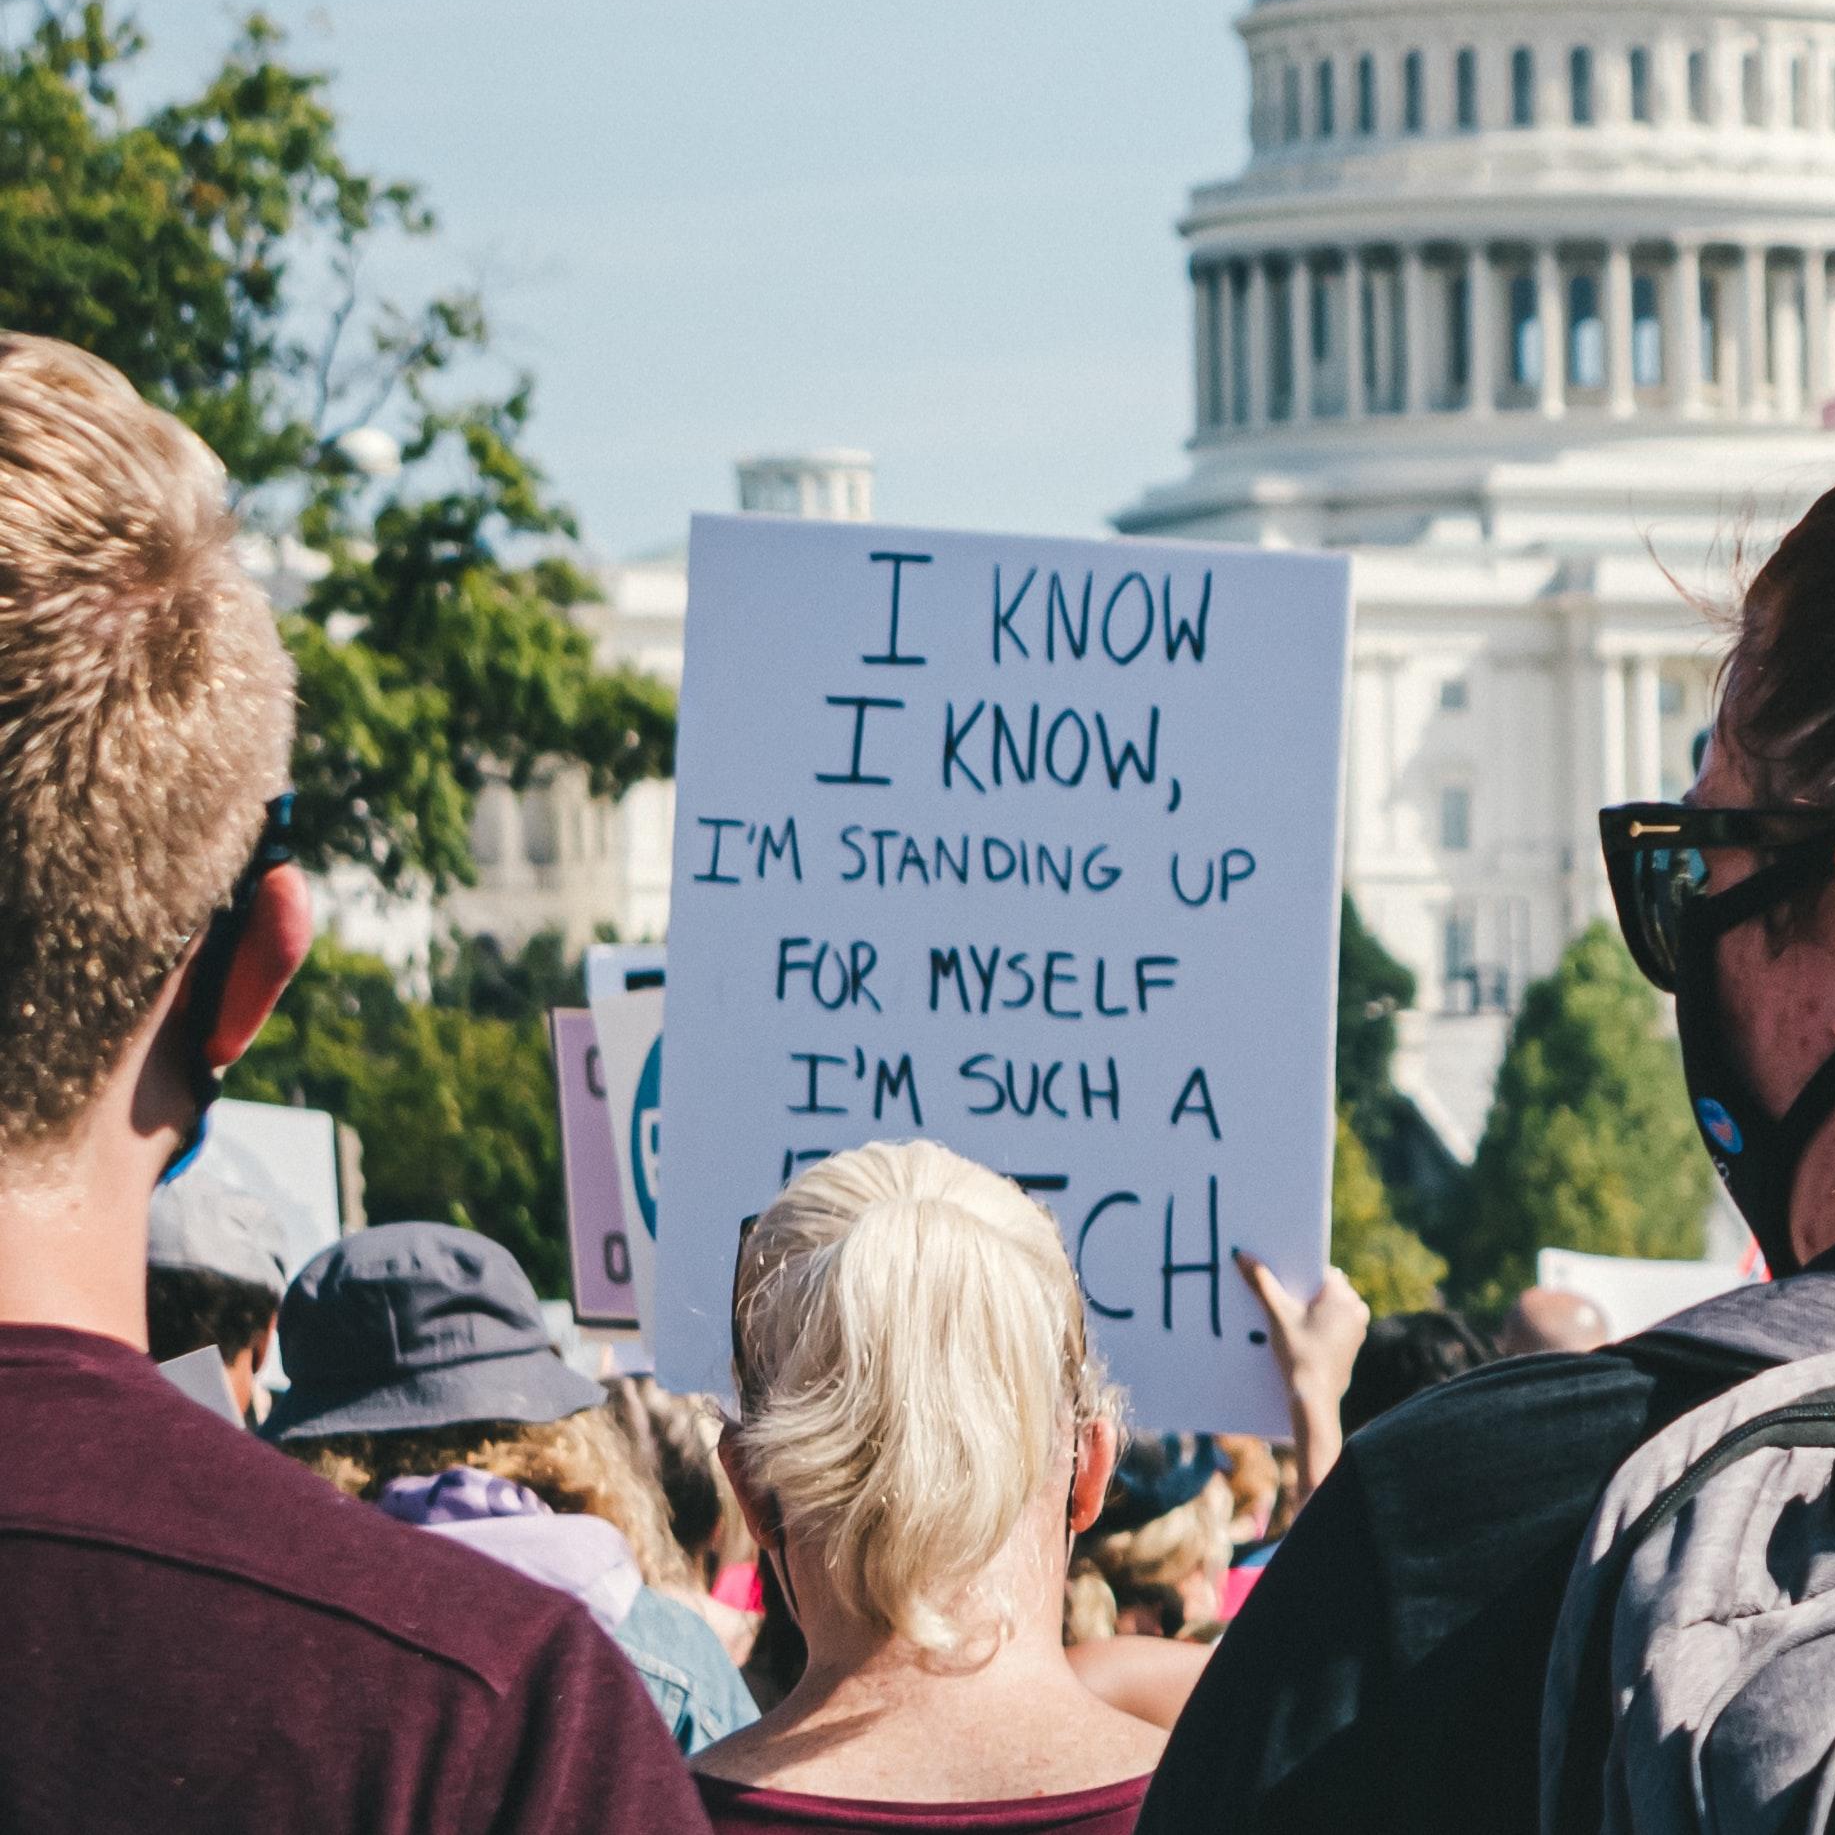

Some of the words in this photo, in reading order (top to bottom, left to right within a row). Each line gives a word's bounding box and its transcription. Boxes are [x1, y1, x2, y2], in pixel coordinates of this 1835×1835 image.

[861, 552, 933, 666] I
[992, 564, 1212, 666] KNOW
[814, 695, 905, 786] I
[942, 700, 1183, 813] KNOW,
[693, 815, 802, 886] I'M
[839, 825, 1122, 895] STANDING
[1171, 847, 1256, 907] UP
[776, 936, 881, 1013] FOR
[928, 945, 1178, 1019] MYSELF
[787, 1046, 922, 1126] I'M
[958, 1054, 1120, 1120] SUCH
[1170, 1065, 1222, 1140] A
